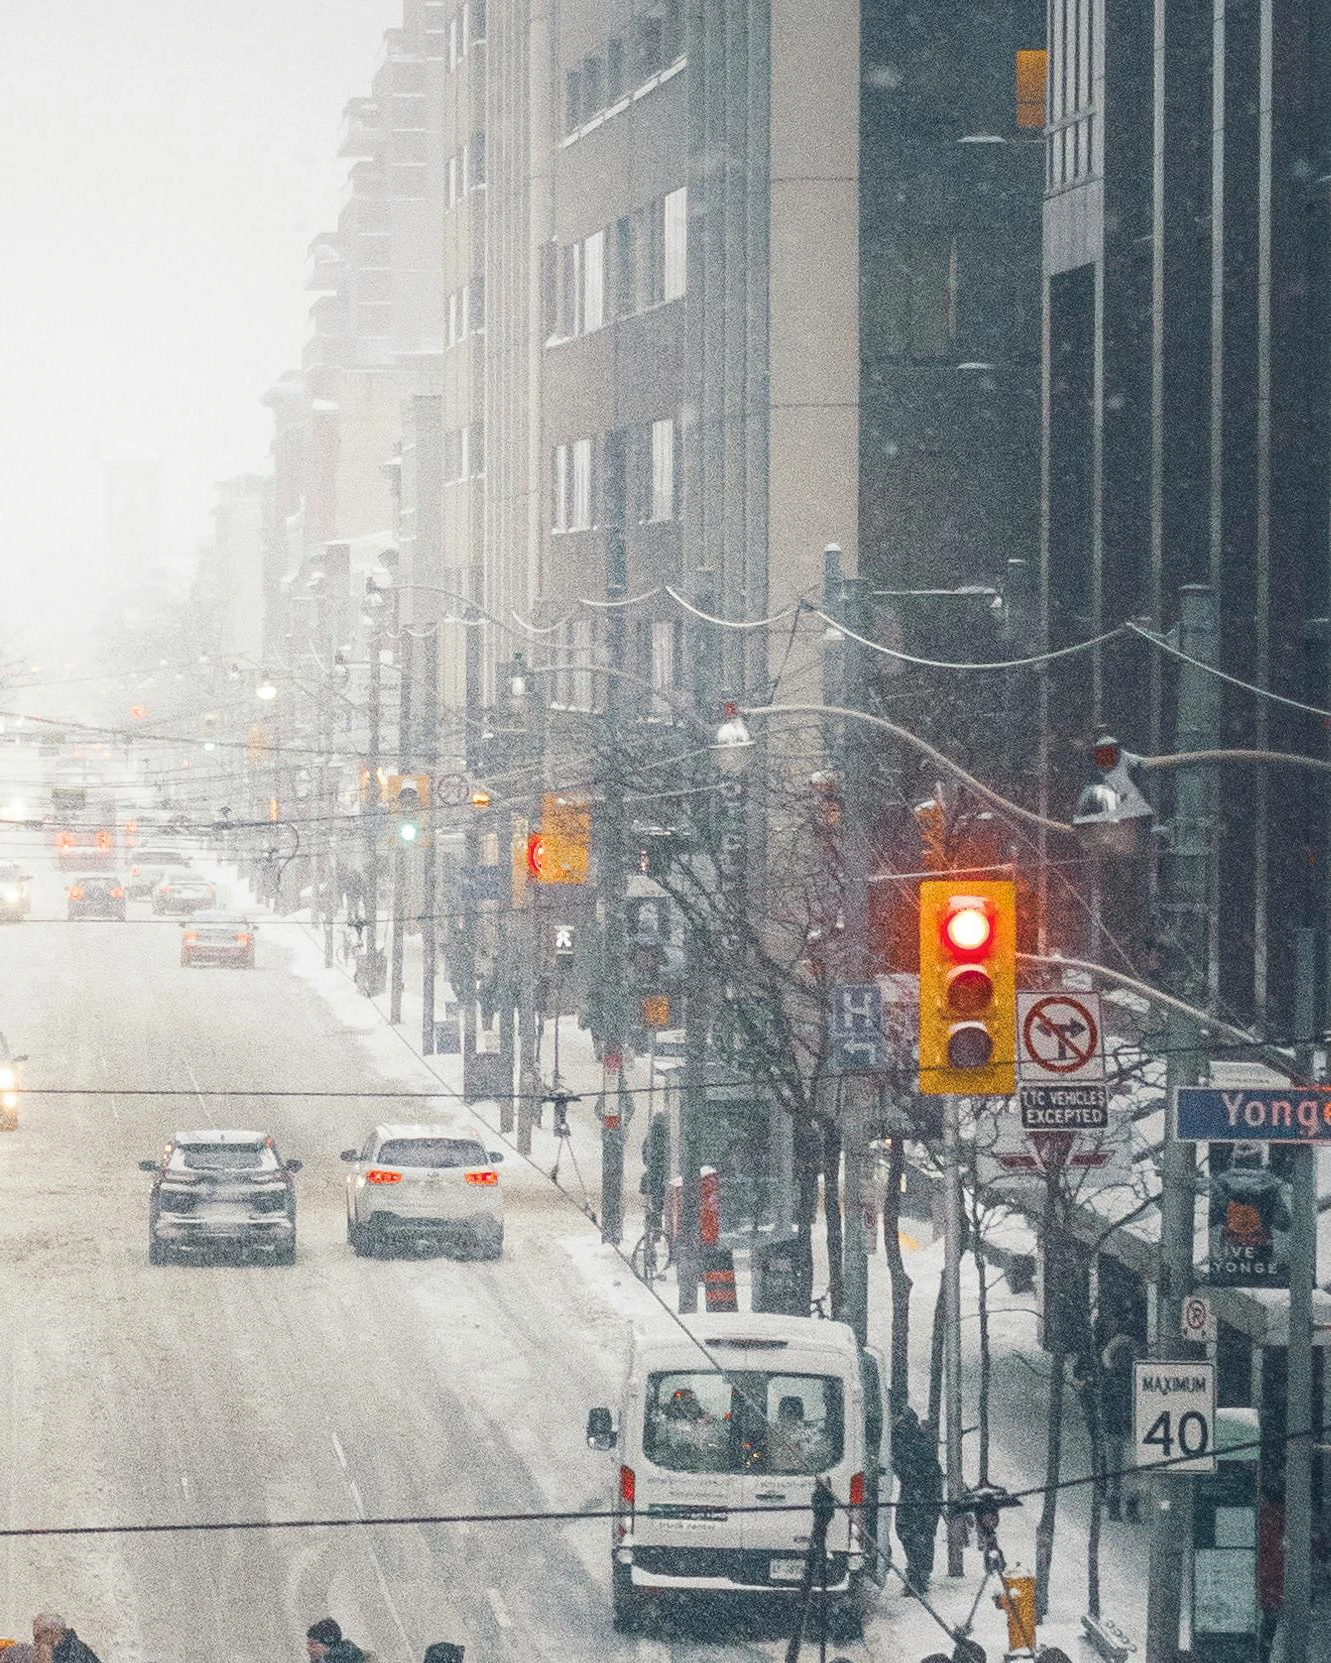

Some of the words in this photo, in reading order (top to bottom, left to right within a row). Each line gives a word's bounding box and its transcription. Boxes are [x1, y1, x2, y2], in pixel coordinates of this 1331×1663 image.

[843, 992, 873, 1028] H
[1021, 1091, 1045, 1105] TTC
[1050, 1091, 1105, 1105] VEHICLES
[1026, 1109, 1102, 1124] EXCEPTED
[1213, 1262, 1277, 1275] YONGE
[1142, 1377, 1206, 1392] MAXIMUM
[1142, 1410, 1209, 1457] 40
